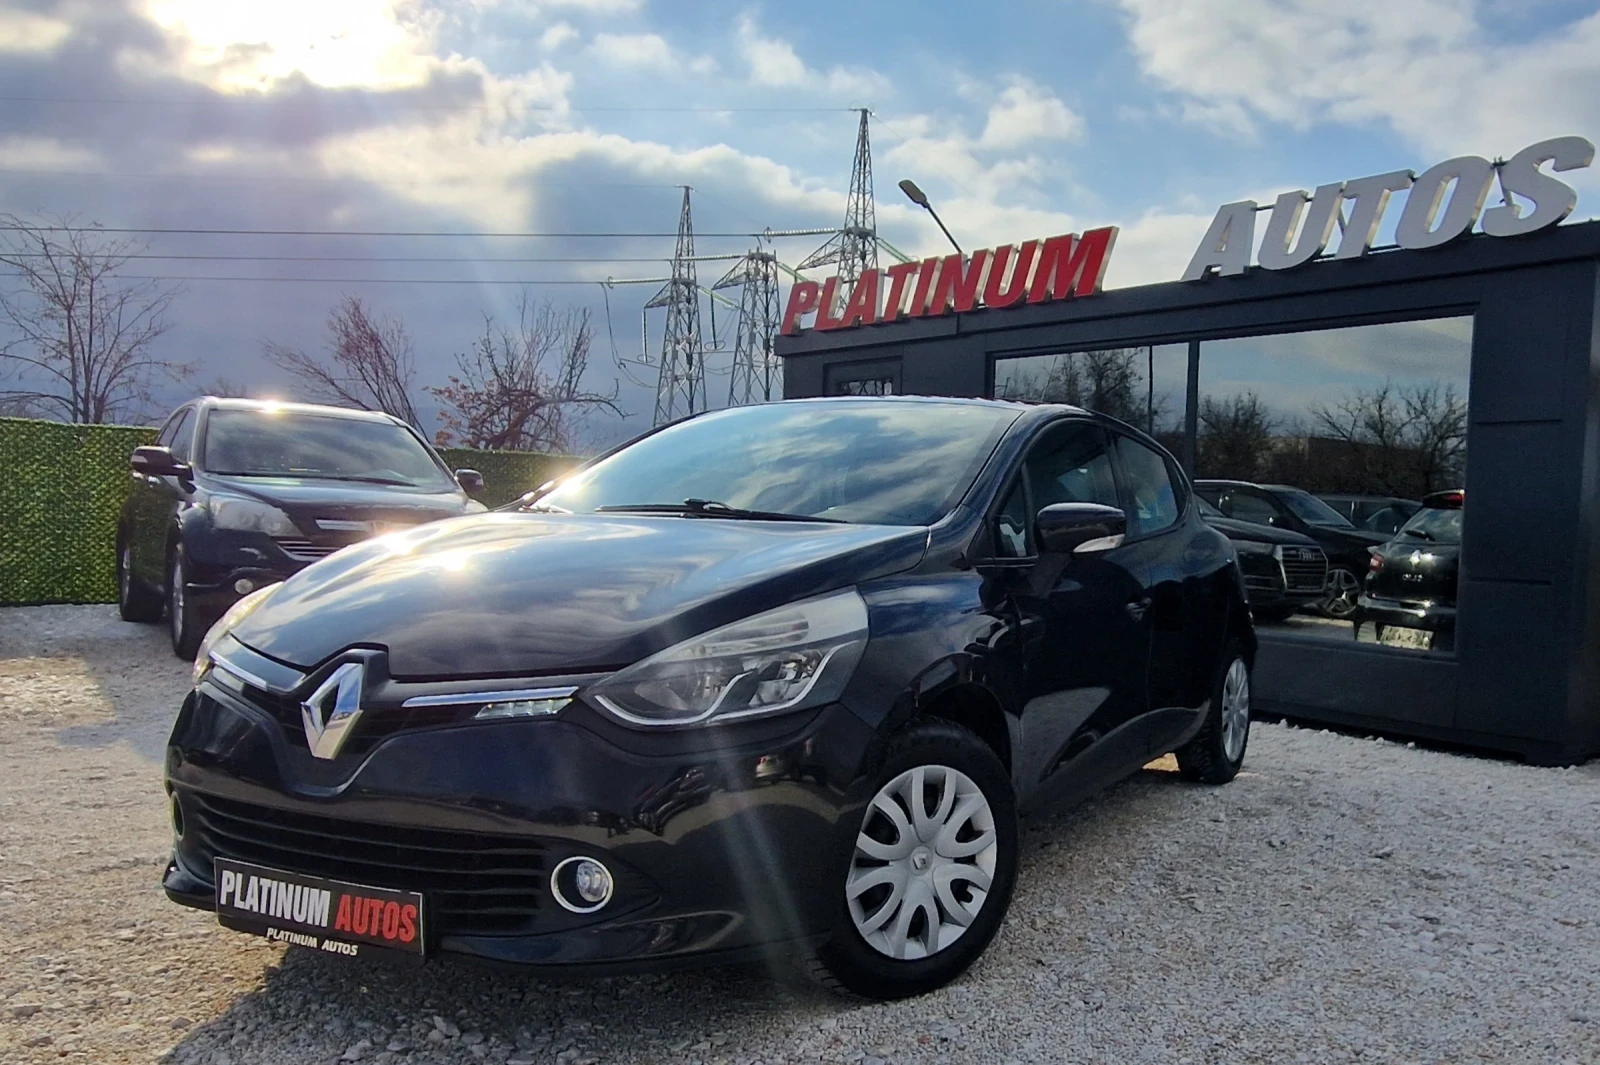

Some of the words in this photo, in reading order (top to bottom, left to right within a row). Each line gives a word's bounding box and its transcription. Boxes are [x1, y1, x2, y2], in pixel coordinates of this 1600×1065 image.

[780, 226, 1119, 335] PLATINUM
[1180, 135, 1595, 282] AUTOS
[219, 870, 331, 928] PLATINUM
[335, 894, 417, 943] AUTOS
[266, 927, 318, 949] PLATINUM
[321, 939, 359, 956] AUTOS
